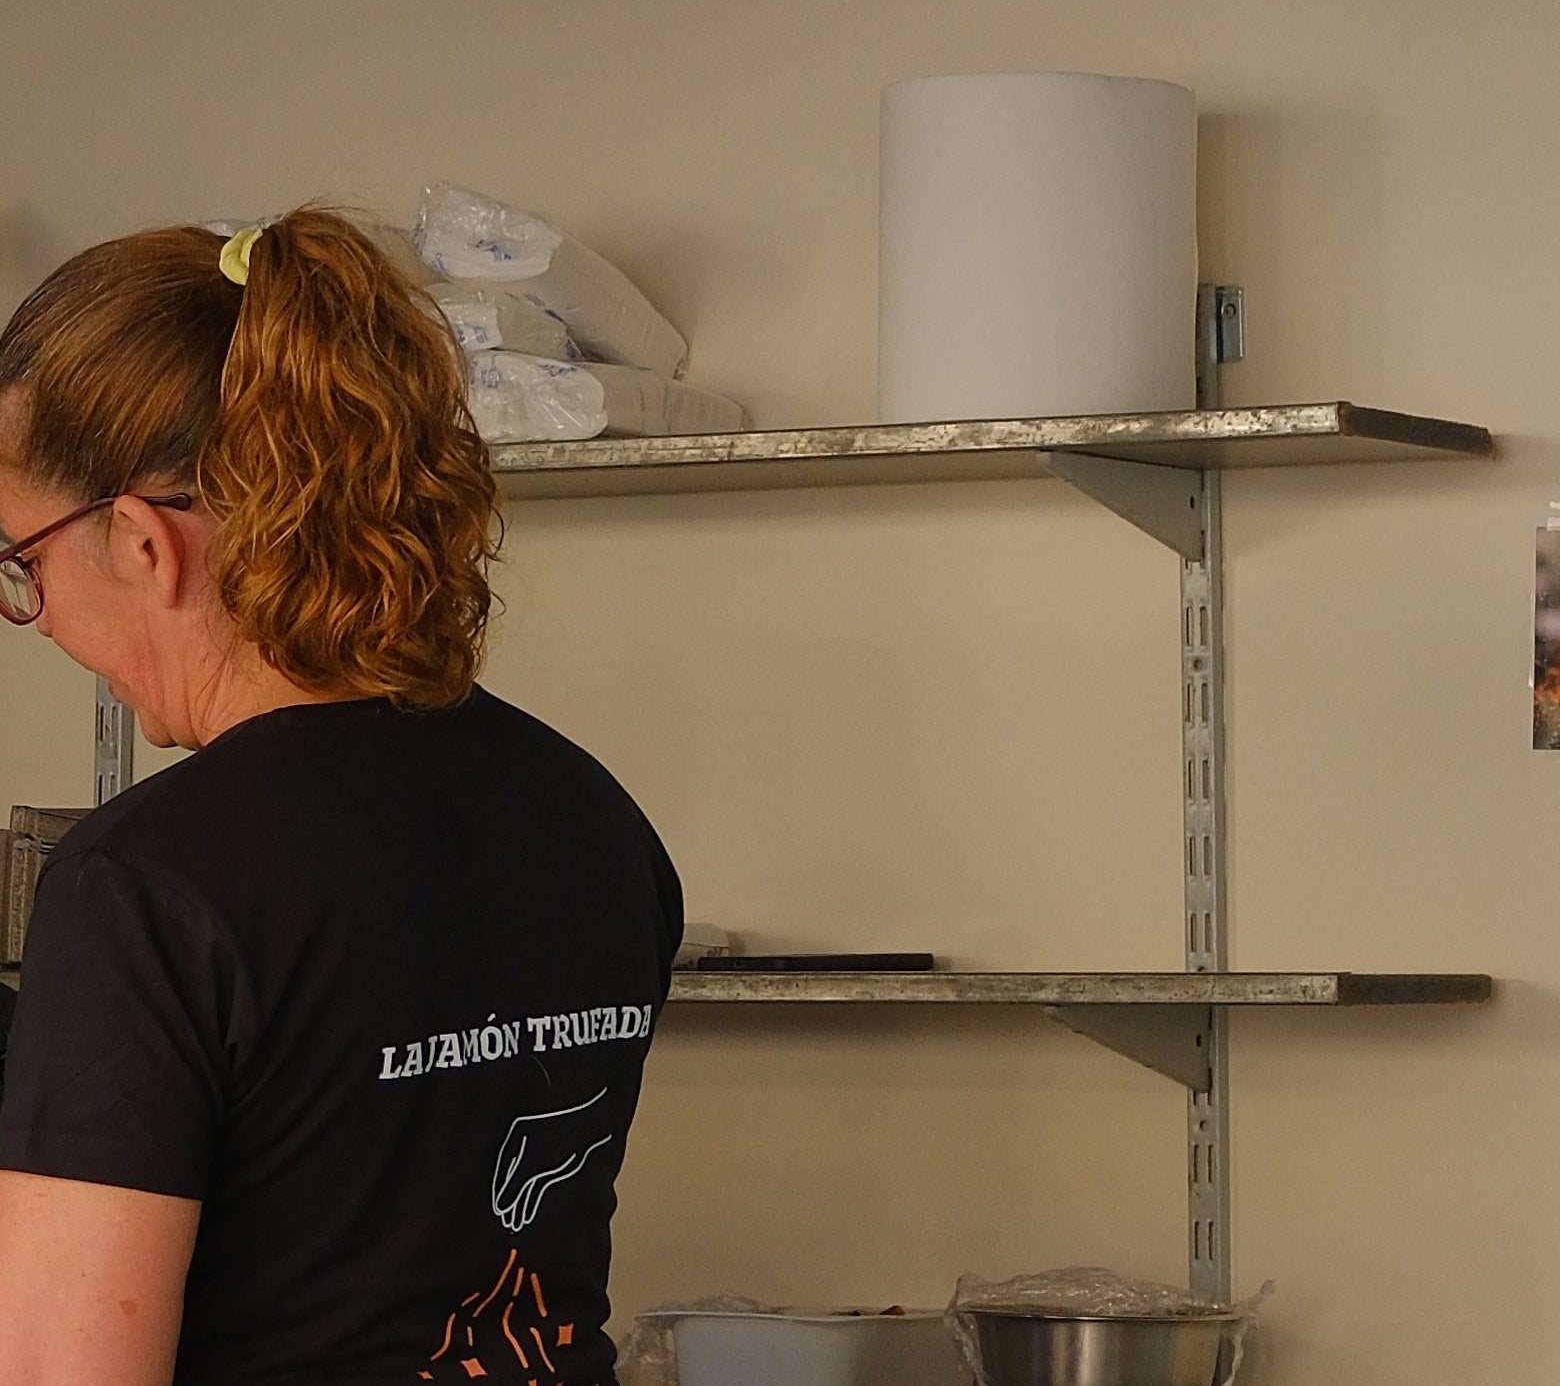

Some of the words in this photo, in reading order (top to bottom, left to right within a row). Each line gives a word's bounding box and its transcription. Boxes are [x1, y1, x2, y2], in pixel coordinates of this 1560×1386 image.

[379, 1042, 423, 1080] LA
[424, 1013, 521, 1074] JAMÓN
[526, 1003, 653, 1053] TRUFADA
